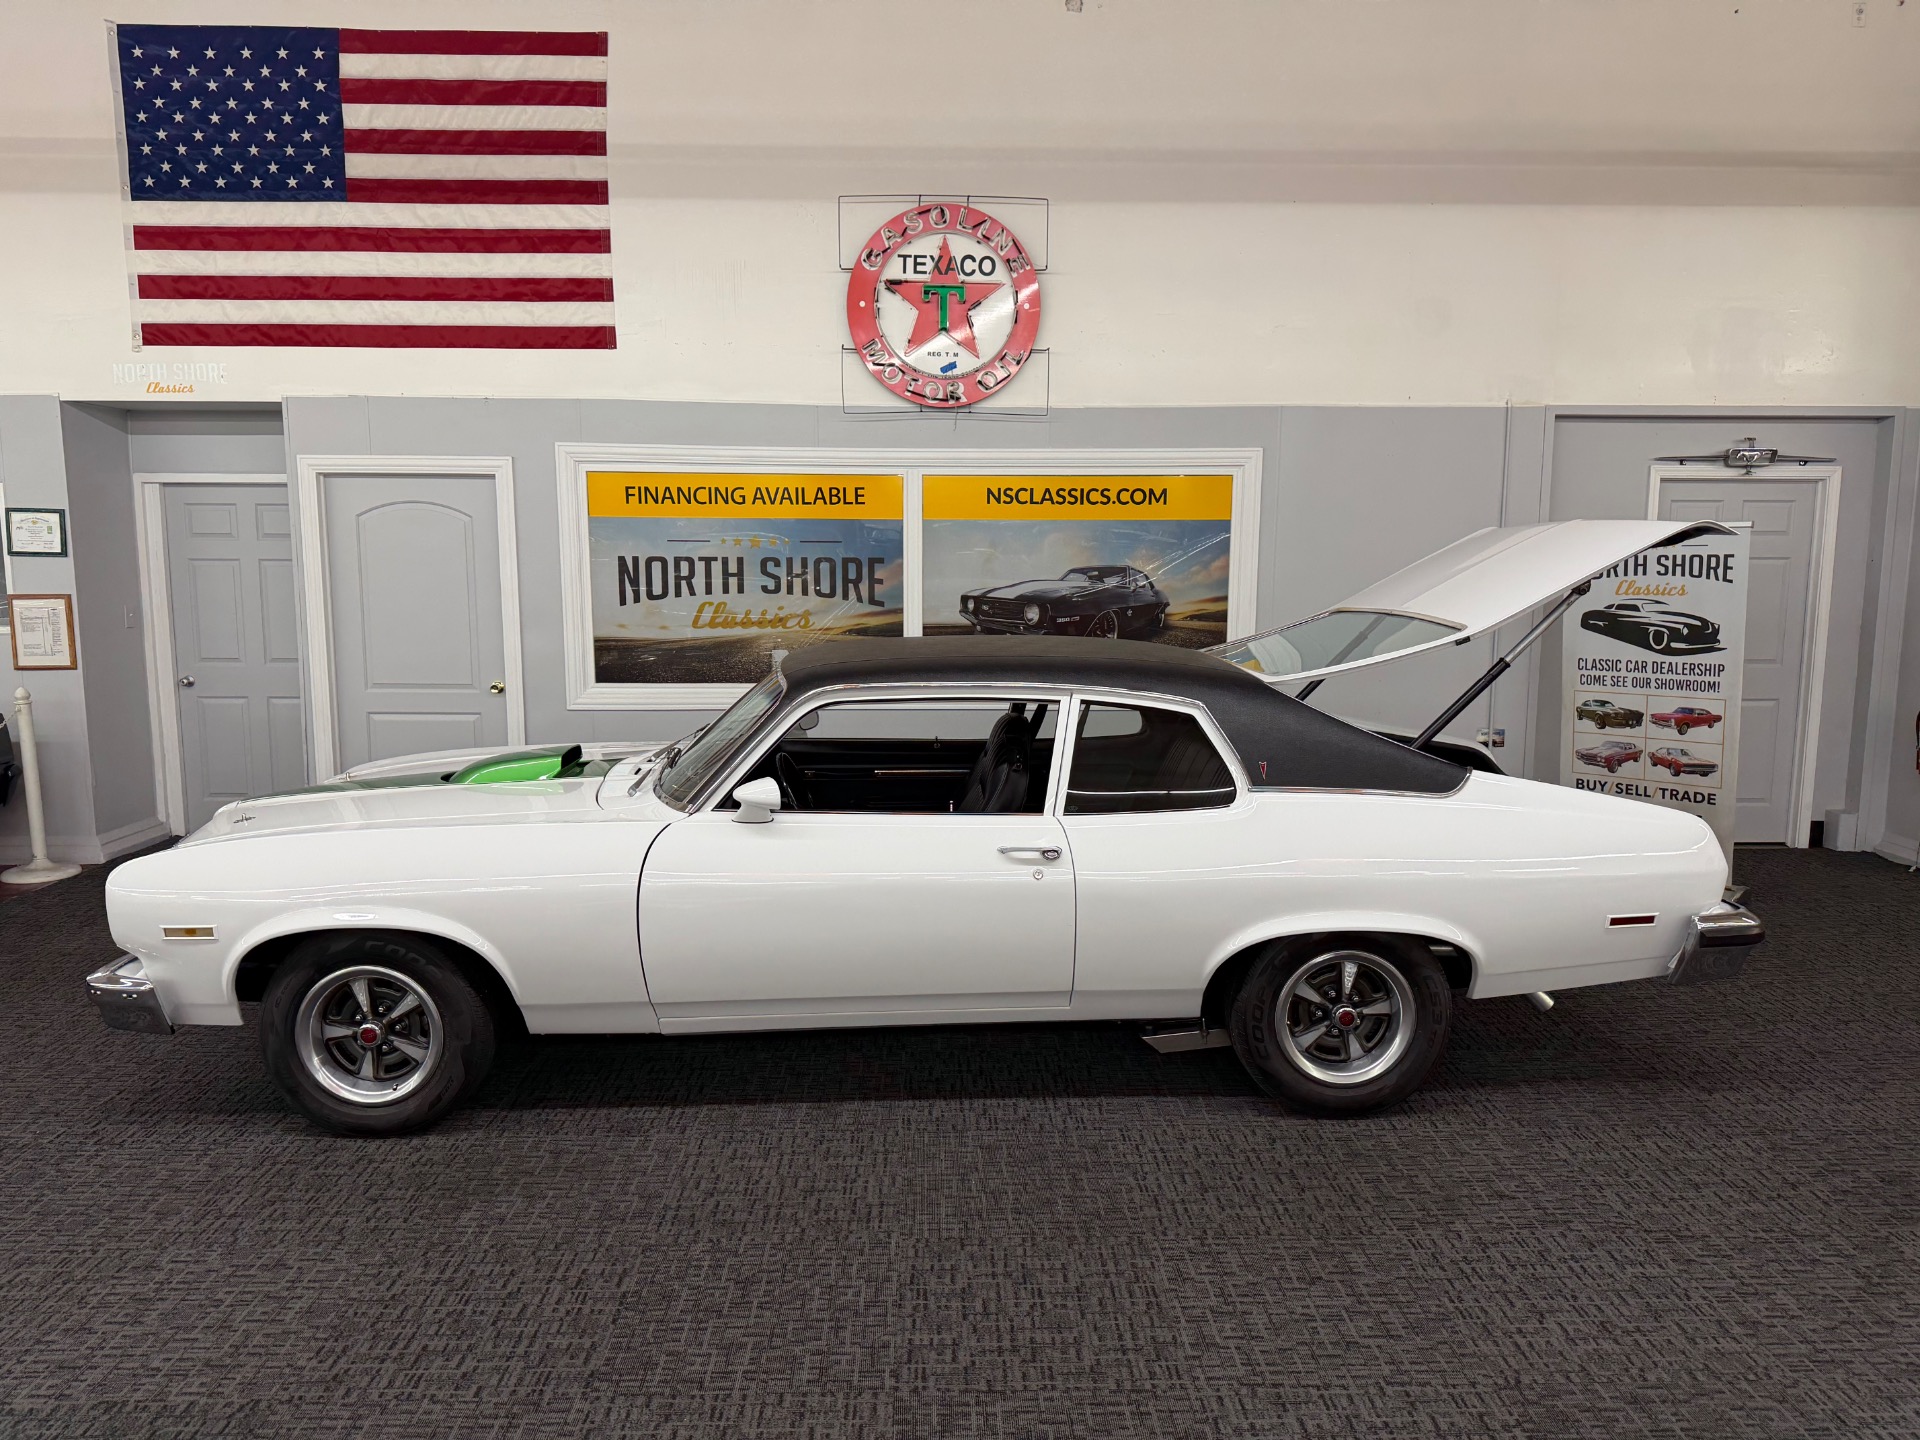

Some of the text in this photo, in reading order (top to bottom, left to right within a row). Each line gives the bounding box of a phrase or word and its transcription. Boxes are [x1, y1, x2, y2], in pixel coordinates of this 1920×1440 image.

[862, 205, 1030, 278] GASOLINE
[897, 254, 996, 276] TEXACO
[922, 284, 966, 331] T
[112, 363, 227, 384] NORTH SHORE
[861, 338, 1026, 404] MOTOR OIL
[146, 382, 195, 394] Classics
[624, 485, 866, 506] FINANCING AVAILABLE
[986, 487, 1168, 506] NSCLASSICS.COM
[1591, 553, 1735, 584] RTH SHORE
[617, 555, 886, 608] NORTH SHORE
[1614, 579, 1689, 597] Classics
[691, 601, 815, 631] Classics
[1577, 657, 1725, 678] CLASSIC CAR DEALERSHIP
[1579, 673, 1721, 693] COME SEE OUR SHOWROOM!
